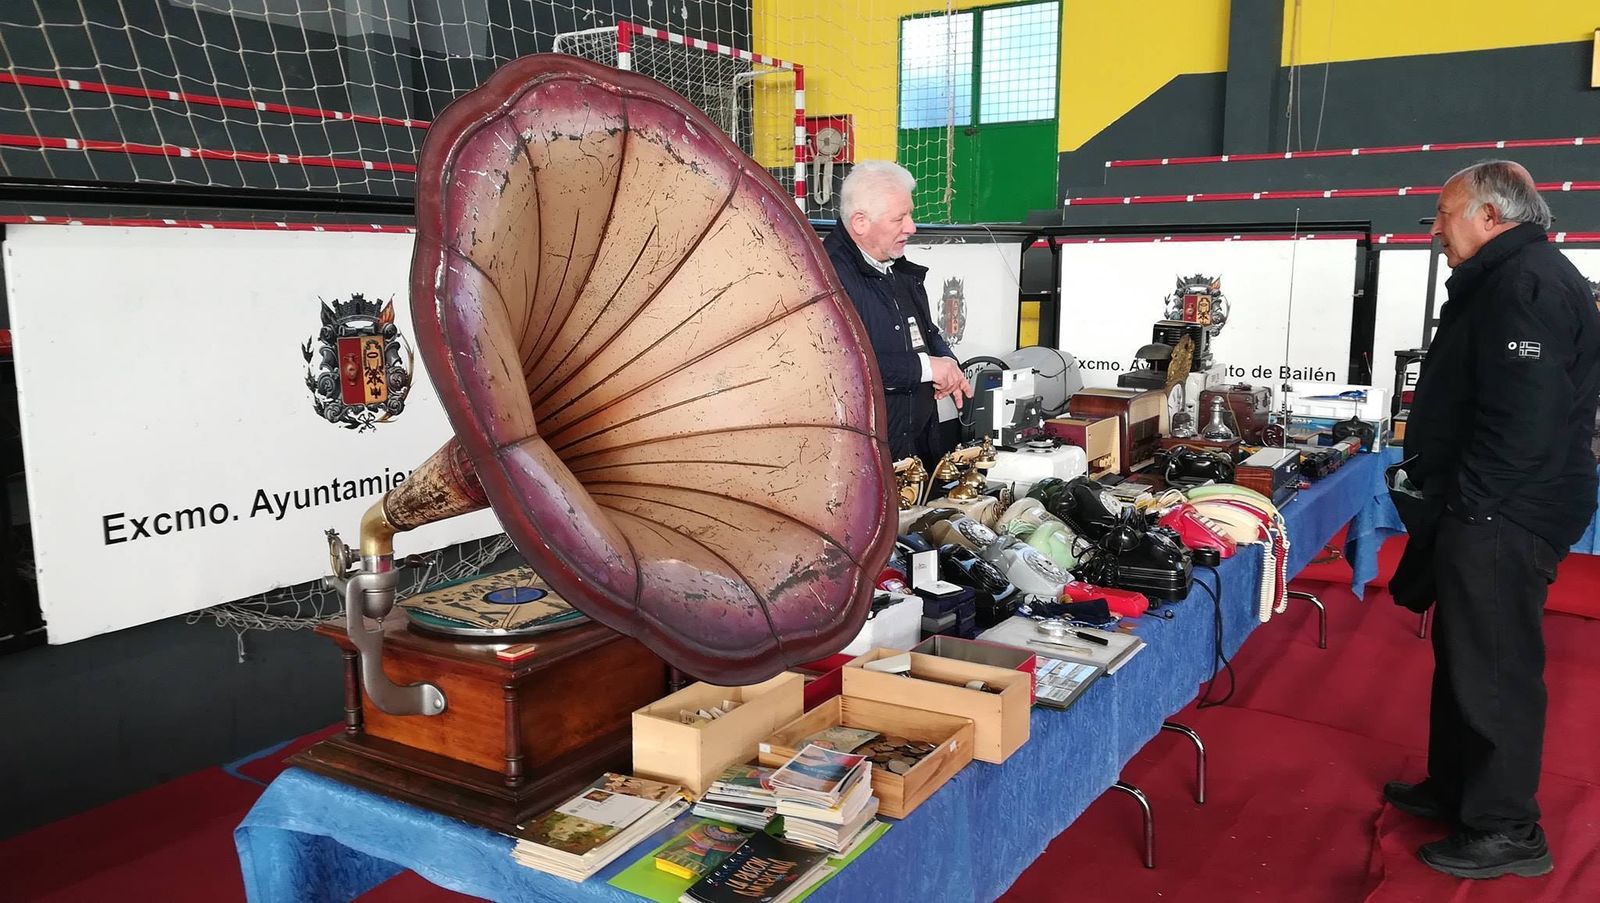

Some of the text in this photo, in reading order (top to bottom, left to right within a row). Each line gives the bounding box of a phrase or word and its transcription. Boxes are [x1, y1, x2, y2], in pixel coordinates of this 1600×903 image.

[1074, 357, 1124, 372] xcmo.
[1252, 366, 1272, 379] de
[1279, 367, 1336, 382] Bailén
[102, 467, 416, 545] Excmo. Ayuntamie
